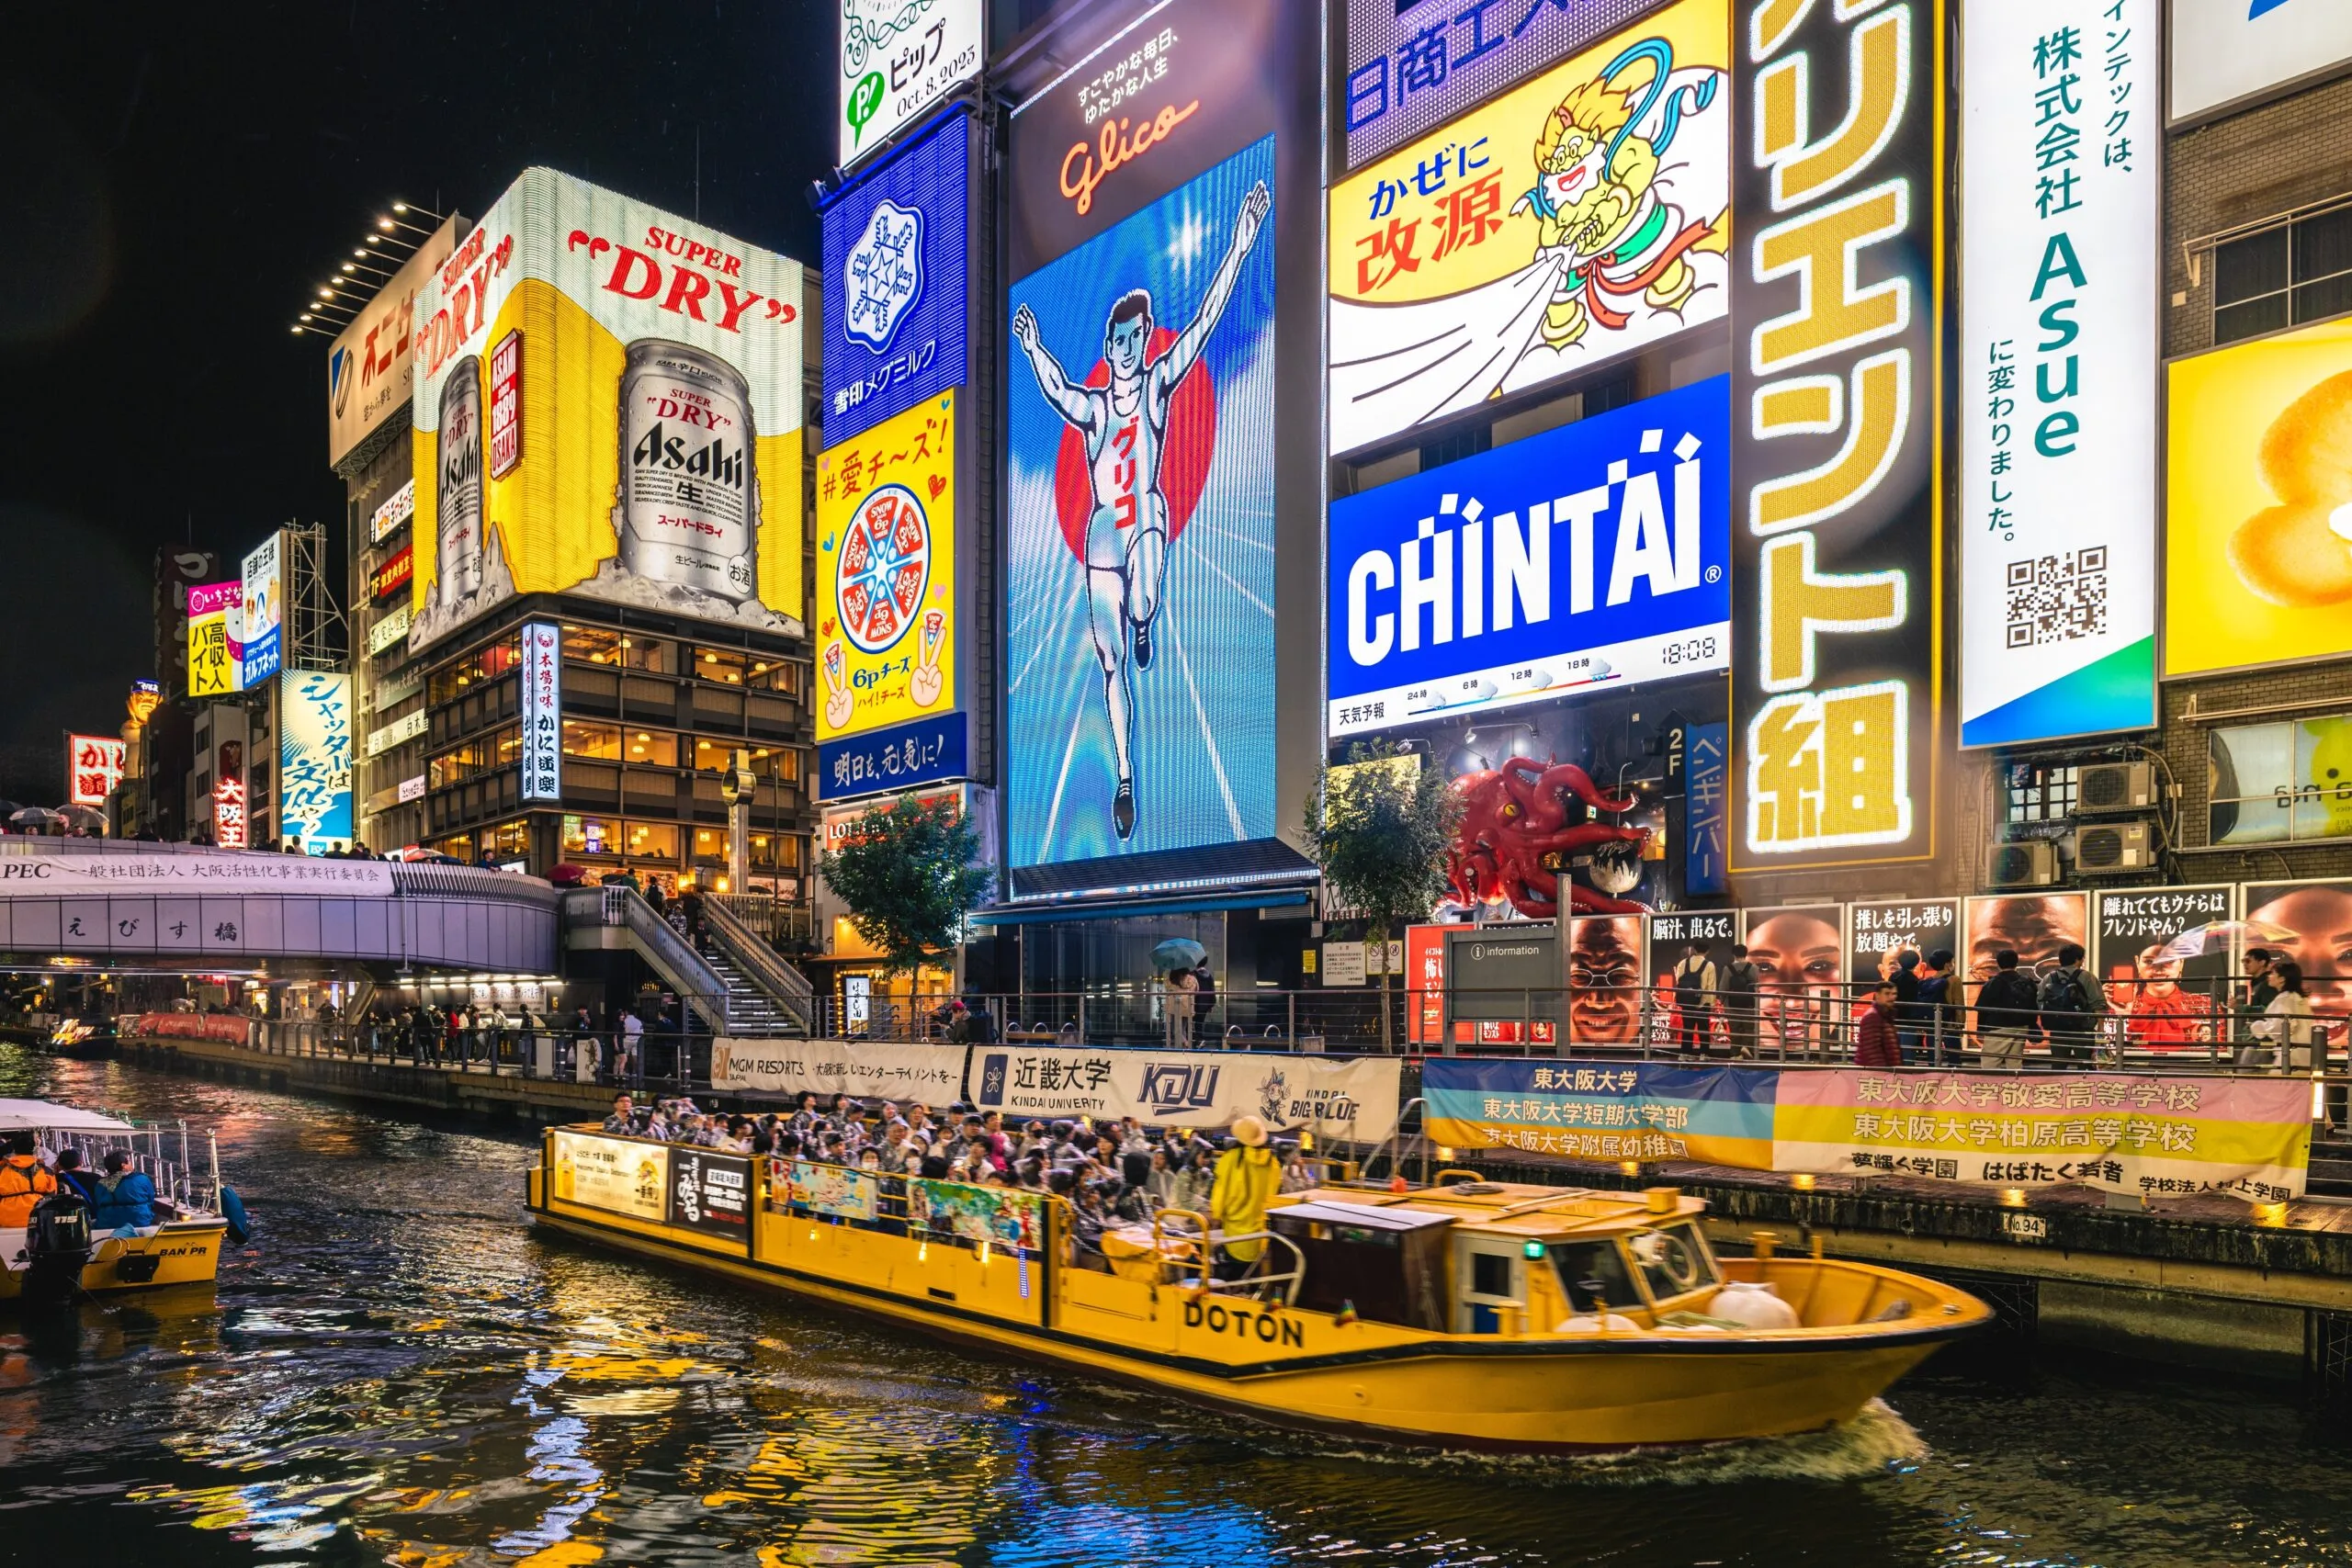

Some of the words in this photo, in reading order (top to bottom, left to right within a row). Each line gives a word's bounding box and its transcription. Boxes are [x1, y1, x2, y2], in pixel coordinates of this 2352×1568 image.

[891, 17, 946, 93] ピップ
[1078, 27, 1179, 107] すこやかな毎日、
[897, 91, 923, 118] Oct.
[1085, 56, 1169, 125] ゆたかな人生
[2033, 26, 2083, 220] 株式会社
[1059, 99, 1199, 216] Glico
[1369, 137, 1490, 220] かぜに
[1356, 167, 1505, 295] 改源
[442, 228, 485, 296] SUPER
[645, 226, 741, 277] SUPER
[2029, 231, 2088, 458] Asue
[492, 341, 516, 391] ASAHI
[655, 359, 677, 369] KARA
[701, 371, 723, 385] KUCHI
[833, 339, 937, 416] 雪印メグミルク
[492, 389, 516, 436] 1889
[670, 389, 712, 407] SUPER
[492, 426, 516, 472] OSAKA
[633, 421, 742, 491] Asahi
[1987, 339, 2016, 542] に変わりました。
[441, 434, 479, 504] Asahi
[1112, 415, 1138, 530] グリコ
[676, 480, 705, 506] 生
[657, 514, 723, 538] スーパードライ
[370, 576, 380, 598] 7F
[729, 563, 752, 587] お酒
[192, 623, 209, 694] バイト
[209, 622, 226, 691] 高収入
[244, 649, 279, 684] ガルフネット
[1663, 637, 1716, 665] 18:08
[538, 651, 554, 708] 本場の味
[1339, 703, 1385, 726] 天気予報
[537, 714, 556, 793] かに道楽
[1669, 728, 1683, 776] 2F
[212, 777, 244, 849] 大阪王
[1692, 736, 1722, 879] ペンギンバー
[69, 863, 185, 879] 一般社団法人
[192, 863, 380, 883] 大阪活性化事業実行委員会
[1855, 906, 1953, 931] 推しを引っ張り
[2103, 893, 2225, 917] 離れててもウチらは
[68, 917, 238, 942] えびす橋
[1855, 931, 1922, 953] 放題やで。
[2103, 916, 2185, 938] フレンドやん?
[1487, 945, 1540, 957] information
[728, 1057, 755, 1075] MGM
[756, 1058, 805, 1077] RESORTS
[1013, 1057, 1112, 1091] 近畿大学
[1533, 1068, 1638, 1093] 東大阪大学
[1011, 1095, 1046, 1109] KINDAI
[1289, 1101, 1312, 1118] BIG
[1314, 1102, 1361, 1121] BLUE
[1483, 1097, 1690, 1130] 東大阪大学短期大学部
[1857, 1077, 2202, 1112] 東大阪大学敬愛高等学校
[1852, 1113, 2198, 1154] 東大阪大学柏原高等学校
[1851, 1151, 1959, 1180] 夢輝く学園
[1982, 1159, 2124, 1185] はばたく若者
[54, 1215, 78, 1224] 115
[159, 1247, 187, 1257] BAN
[189, 1247, 208, 1255] PR
[1182, 1301, 1305, 1349] DOTON
